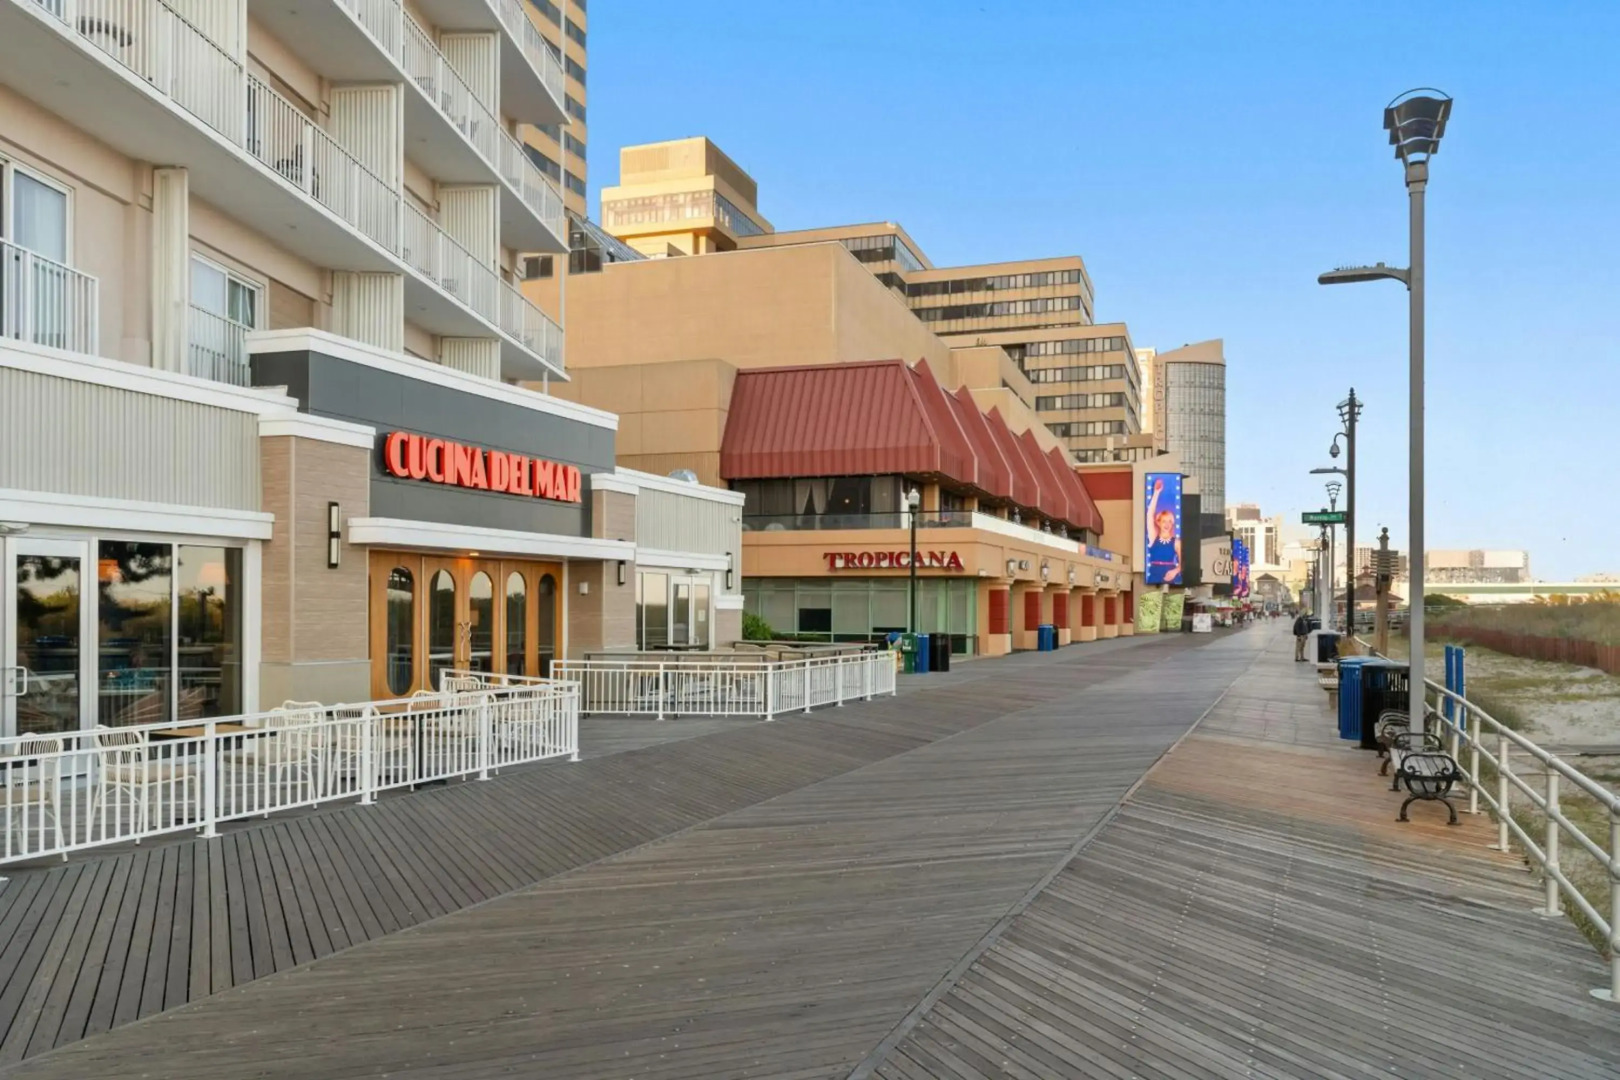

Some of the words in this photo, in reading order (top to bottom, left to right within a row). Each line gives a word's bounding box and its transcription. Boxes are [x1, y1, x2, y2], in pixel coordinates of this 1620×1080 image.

[385, 431, 488, 490] CUCINA
[488, 449, 533, 496] DEL
[532, 458, 582, 503] MAR
[823, 551, 965, 573] TROPICANA
